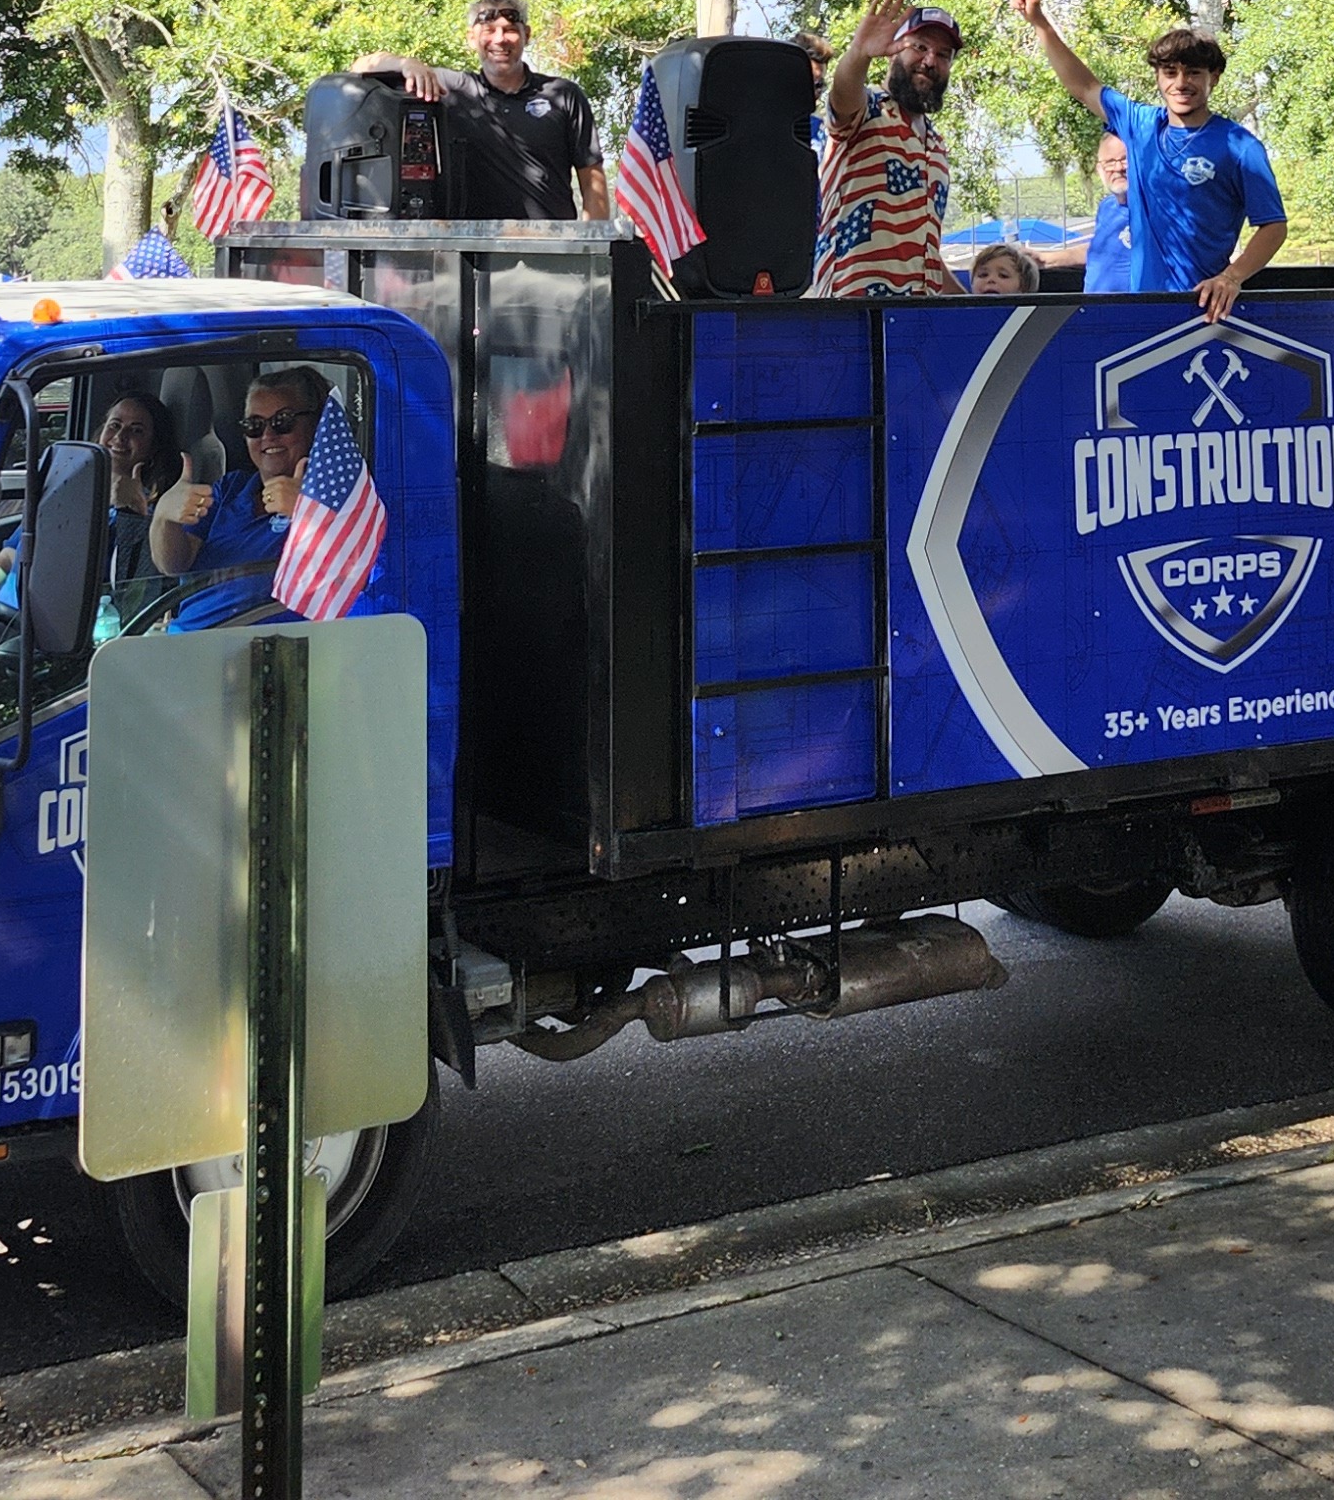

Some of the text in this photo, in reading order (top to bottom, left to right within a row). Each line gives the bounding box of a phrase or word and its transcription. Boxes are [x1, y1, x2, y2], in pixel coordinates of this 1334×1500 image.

[1162, 551, 1282, 588] CORPS
[1104, 711, 1150, 739] 35+
[1157, 703, 1221, 731] Years
